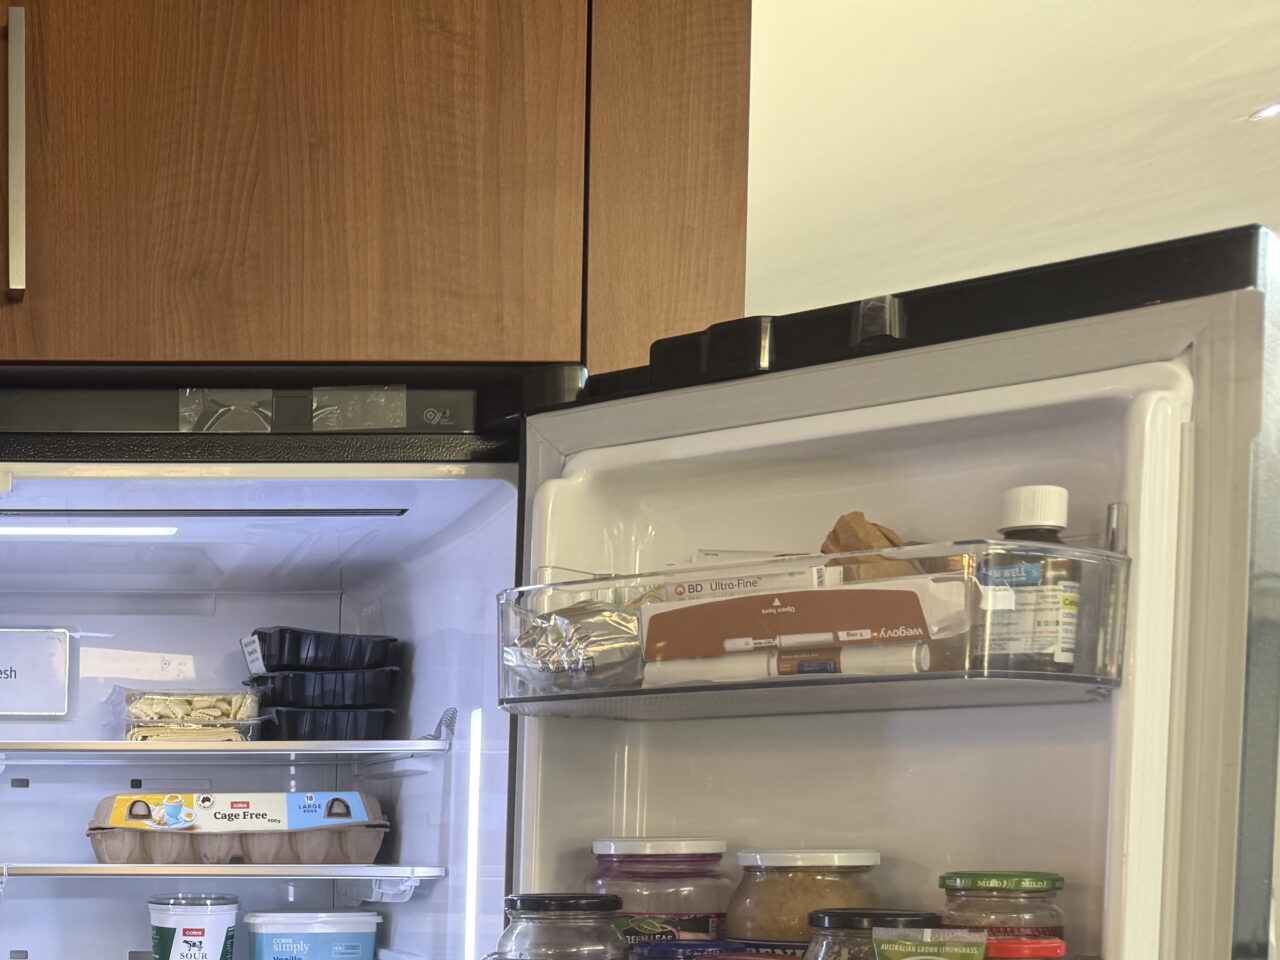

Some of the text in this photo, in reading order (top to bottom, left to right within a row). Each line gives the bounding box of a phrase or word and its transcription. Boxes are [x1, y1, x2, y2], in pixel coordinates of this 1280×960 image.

[687, 583, 703, 594] BD
[761, 606, 795, 614] Open here
[879, 626, 923, 638] wegovy
[213, 810, 267, 820] Cage Free
[272, 940, 310, 955] simply
[880, 943, 978, 954] AUSTRALIAN GROWN LEMONGRASS
[179, 952, 208, 960] SOUR
